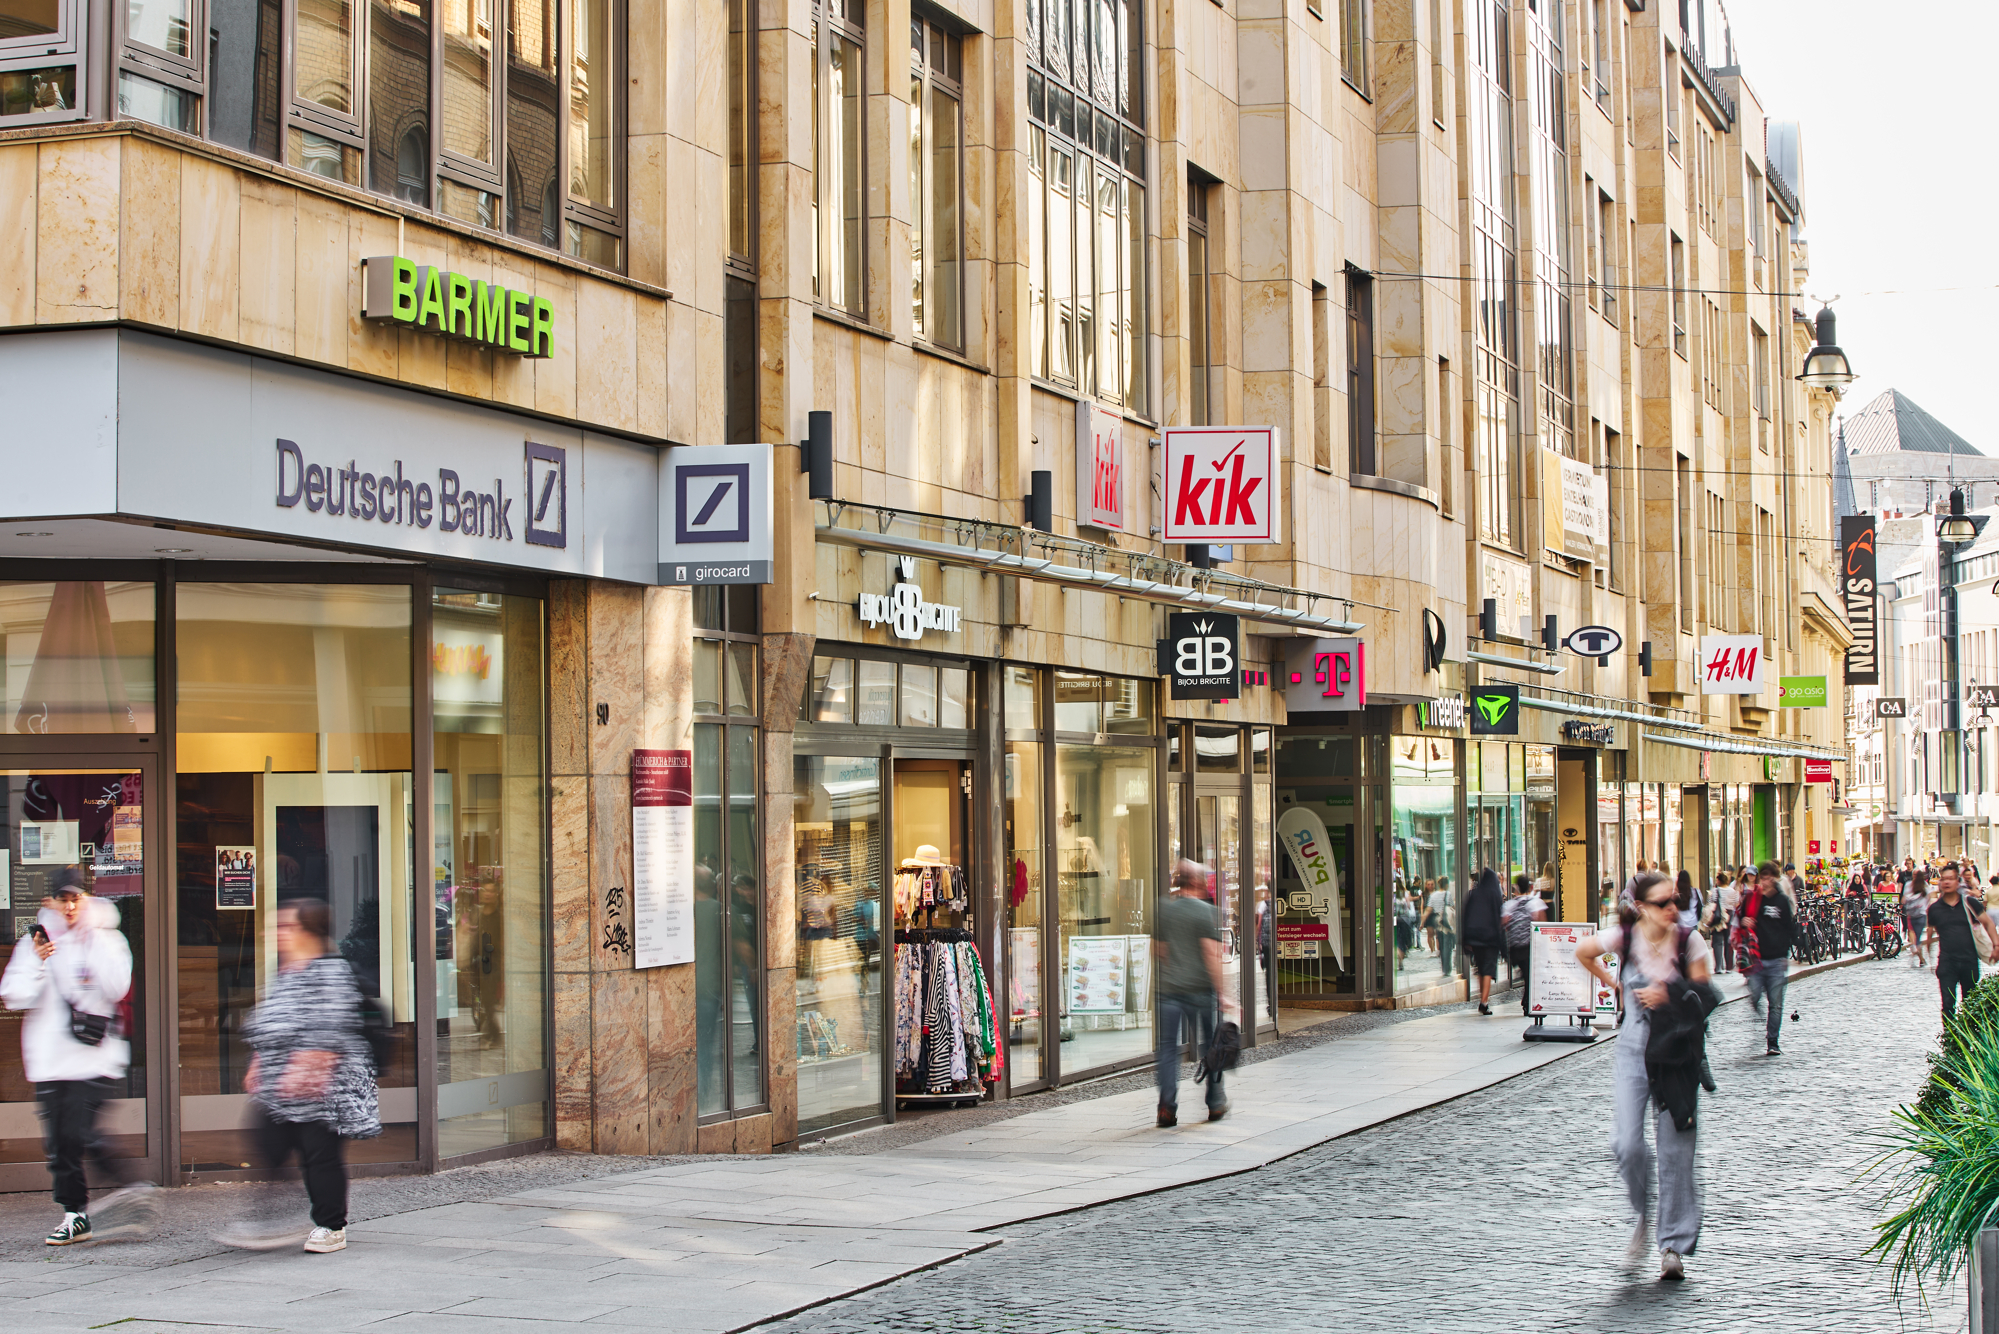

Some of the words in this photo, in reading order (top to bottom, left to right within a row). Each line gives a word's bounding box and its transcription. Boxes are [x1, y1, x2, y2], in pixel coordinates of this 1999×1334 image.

[393, 256, 554, 359] BARMER
[276, 438, 433, 528] Deutsche
[439, 468, 514, 541] Bank
[695, 564, 750, 581] girocard
[1847, 578, 1875, 673] SATURN
[1707, 646, 1758, 682] H&M
[1177, 678, 1198, 687] BIJOU
[1200, 677, 1231, 685] BRIGITTE
[1788, 687, 1803, 699] go
[1804, 684, 1825, 695] asia
[597, 702, 610, 726] 90
[1879, 701, 1902, 714] C&A
[668, 756, 688, 766] PARTNER
